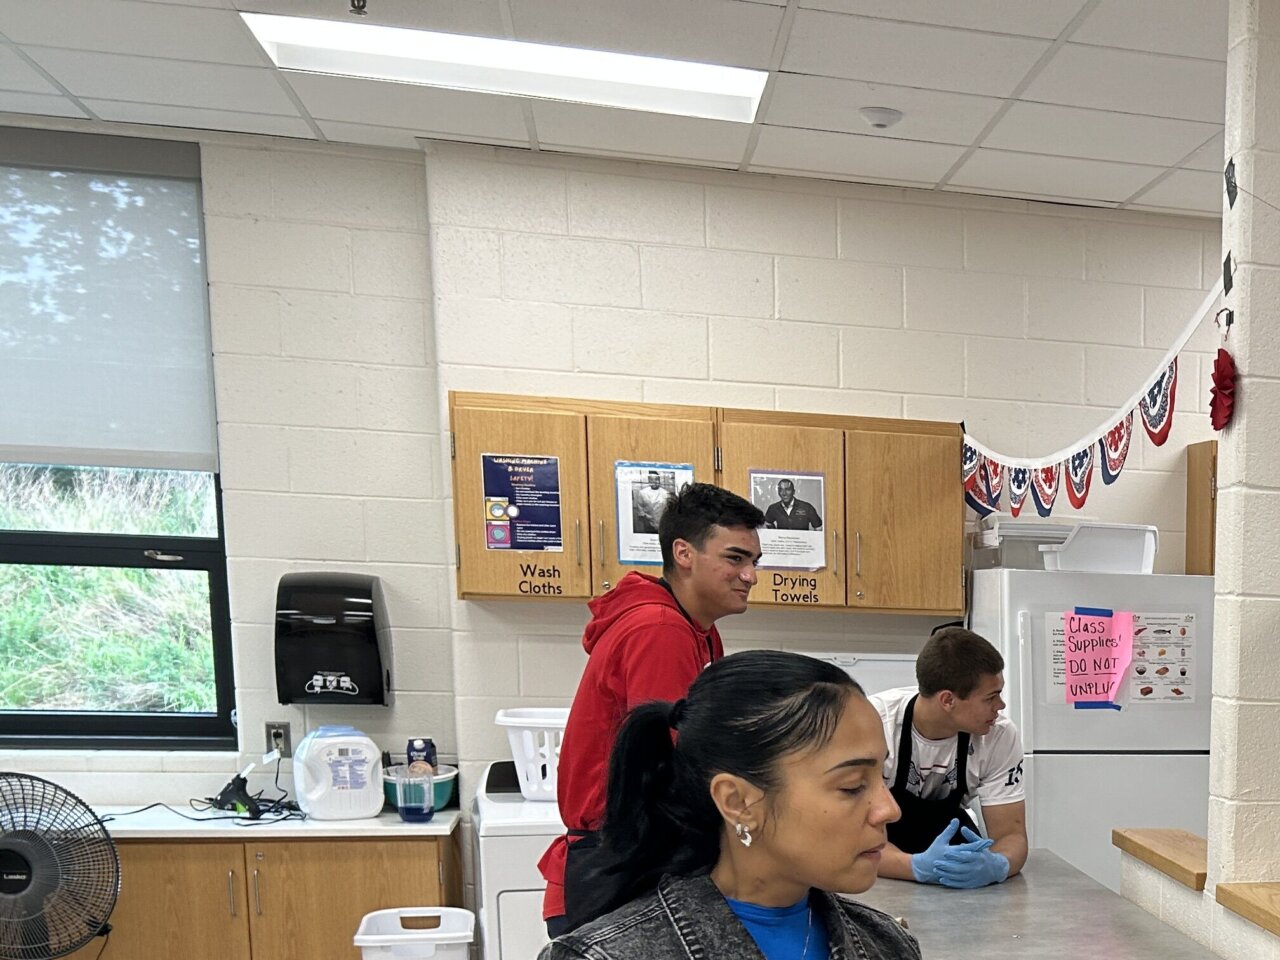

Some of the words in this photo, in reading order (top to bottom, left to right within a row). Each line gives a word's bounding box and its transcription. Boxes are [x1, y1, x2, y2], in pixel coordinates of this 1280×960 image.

[519, 563, 561, 579] Wash
[518, 580, 562, 595] Cloths
[773, 573, 817, 590] Drying
[771, 590, 819, 603] Towels
[1069, 616, 1105, 634] Class
[1069, 658, 1087, 674] DO
[1093, 657, 1120, 671] NOT
